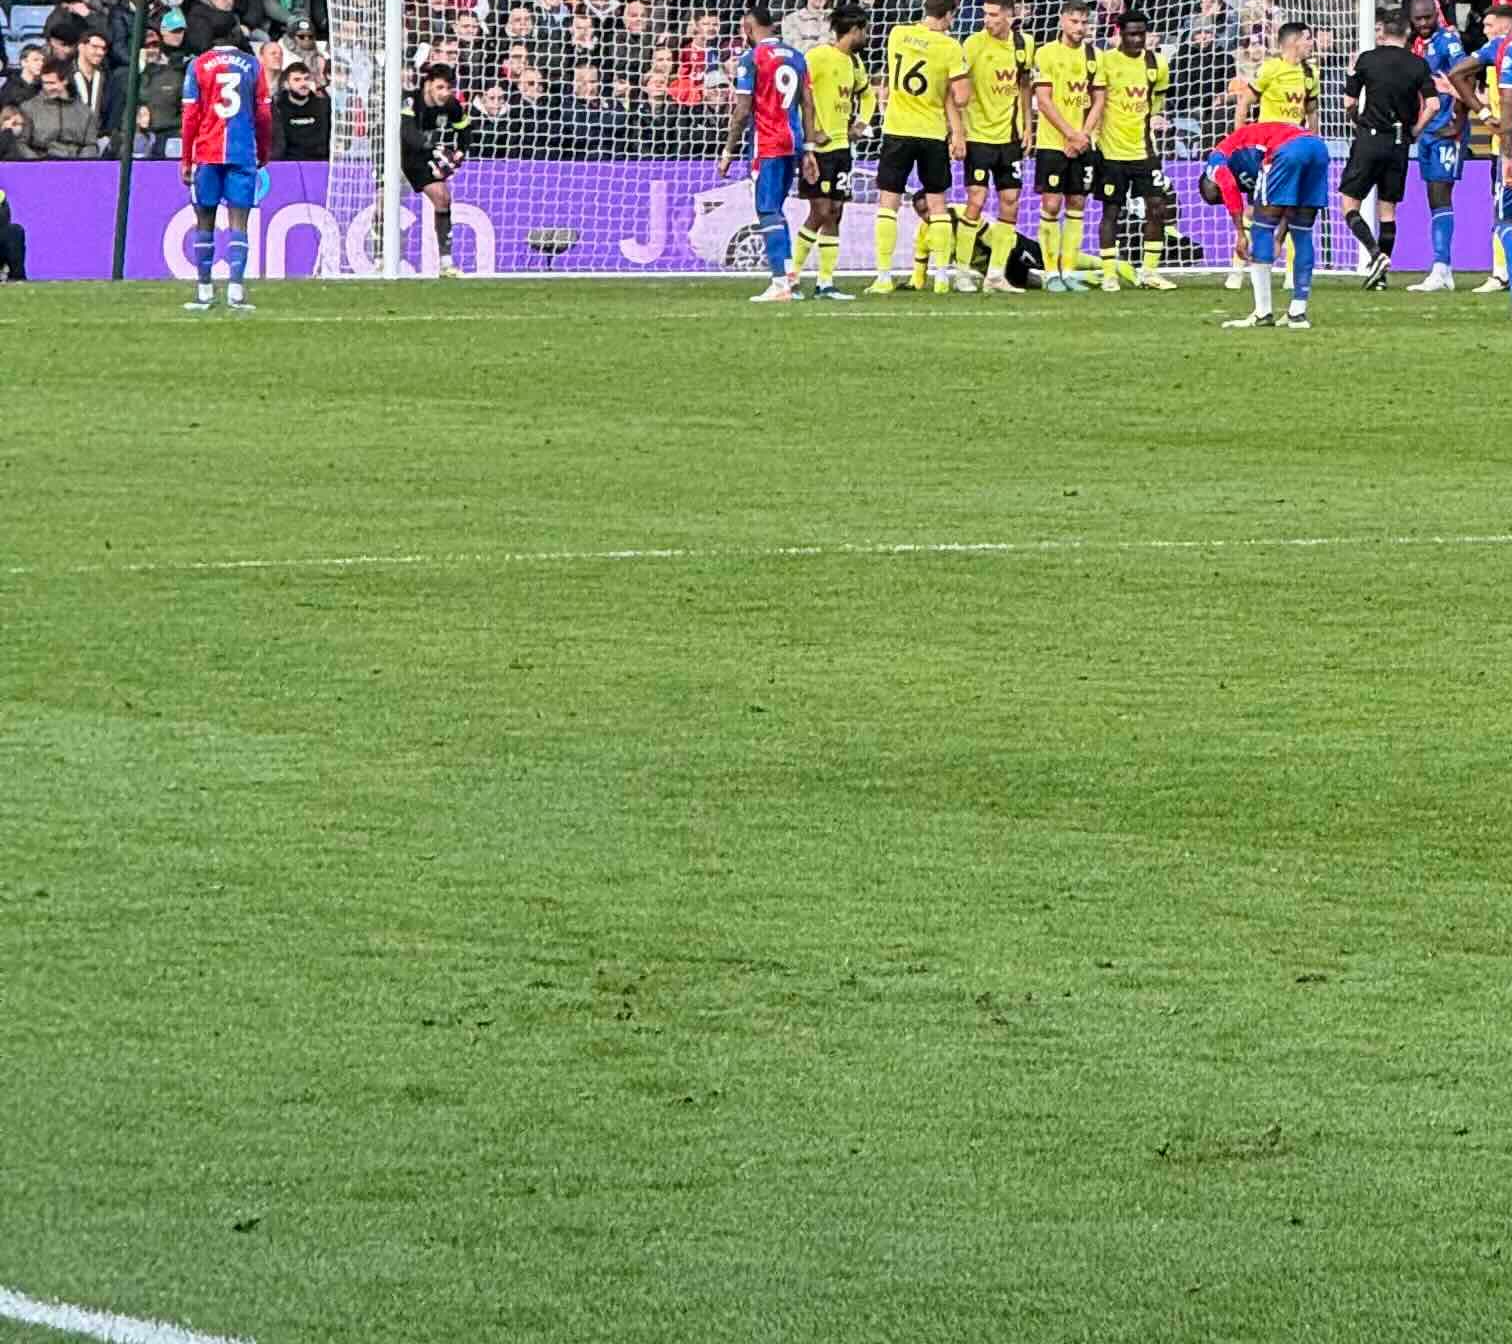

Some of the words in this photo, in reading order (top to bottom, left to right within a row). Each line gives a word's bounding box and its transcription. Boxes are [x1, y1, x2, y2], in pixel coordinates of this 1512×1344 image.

[213, 73, 241, 118] 3
[775, 65, 798, 108] 9
[894, 53, 928, 96] 16
